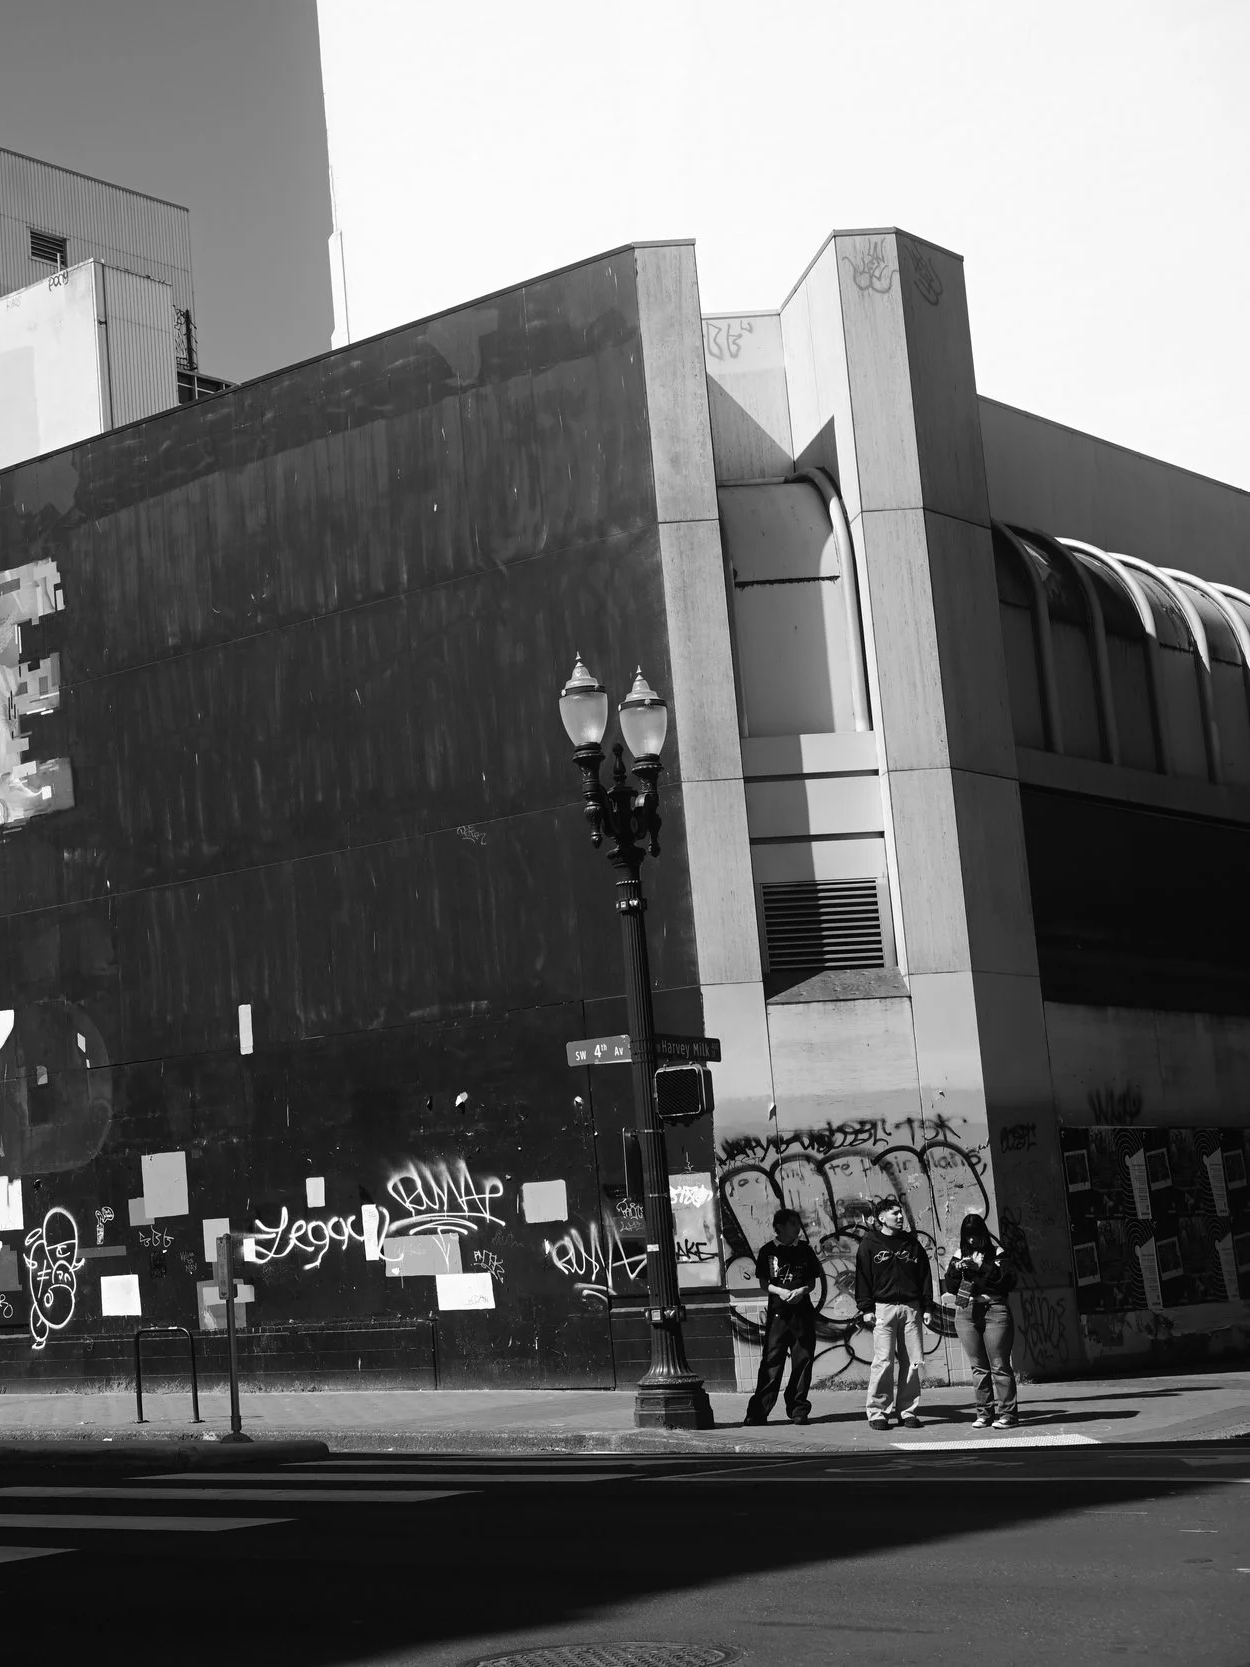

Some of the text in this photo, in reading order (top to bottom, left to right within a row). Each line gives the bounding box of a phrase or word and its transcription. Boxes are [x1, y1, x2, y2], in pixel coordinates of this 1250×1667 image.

[575, 1043, 624, 1061] SW 4th Av
[661, 1039, 710, 1059] Harvey Milk
